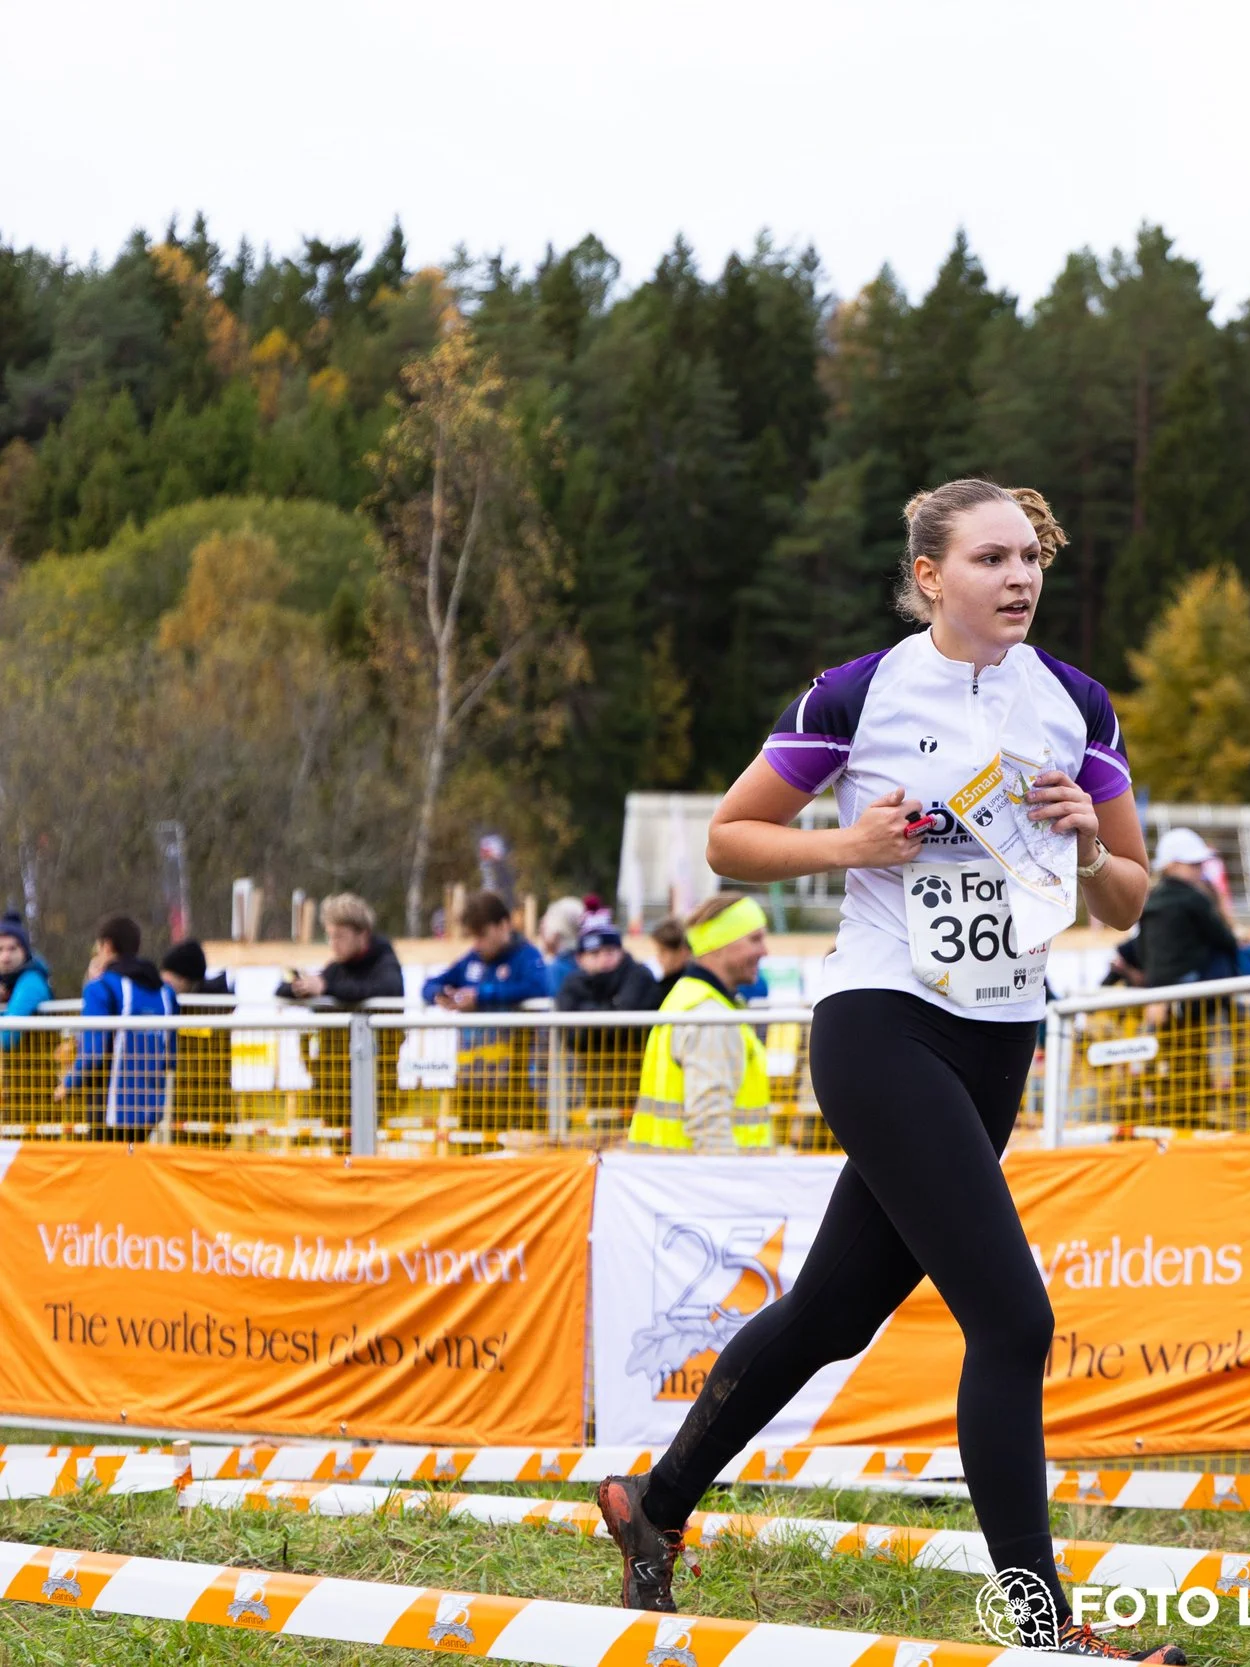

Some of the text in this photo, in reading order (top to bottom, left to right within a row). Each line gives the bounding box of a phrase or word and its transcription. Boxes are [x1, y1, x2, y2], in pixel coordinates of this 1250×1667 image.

[38, 1222, 186, 1272] Världens
[192, 1229, 285, 1280] bästa
[291, 1235, 390, 1284] klubb
[45, 1301, 108, 1347] The
[117, 1310, 238, 1358] world's
[246, 1317, 319, 1365] best
[1045, 1331, 1125, 1380] The
